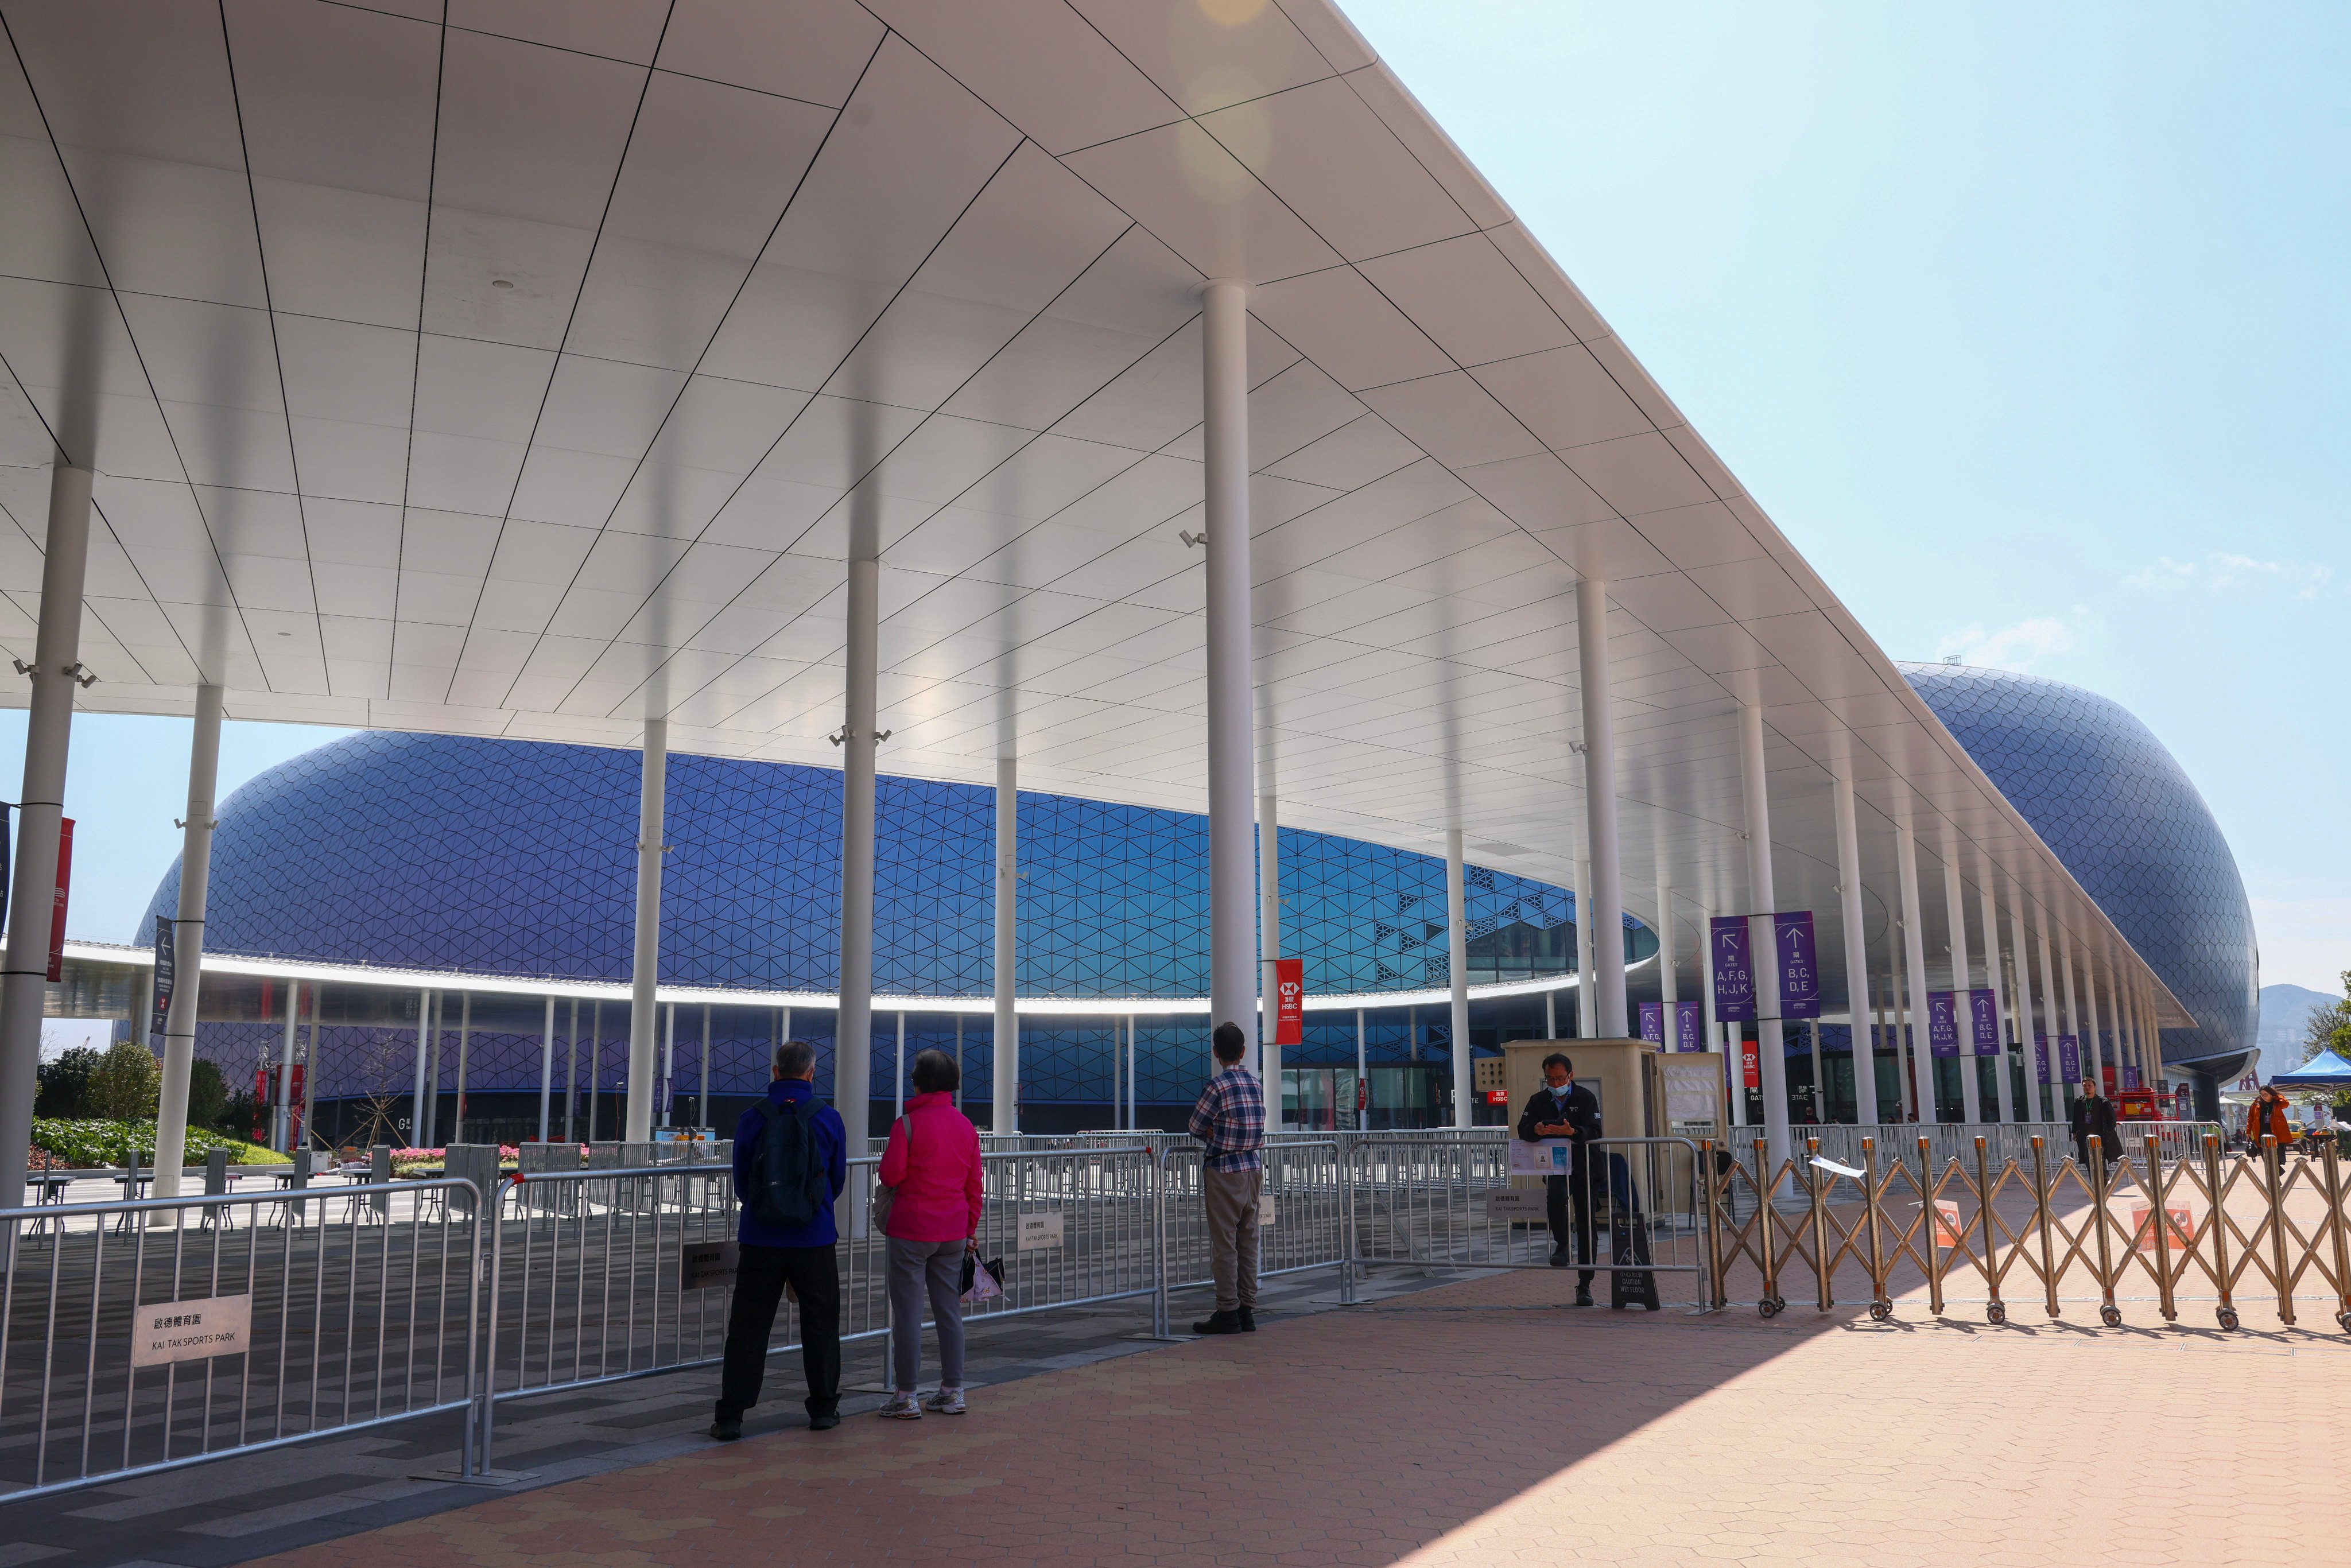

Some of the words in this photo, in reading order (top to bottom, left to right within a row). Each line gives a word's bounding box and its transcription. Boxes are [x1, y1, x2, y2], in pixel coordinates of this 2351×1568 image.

[398, 1118, 405, 1130] G
[153, 1313, 201, 1330] 啟德體育園
[152, 1341, 165, 1350] KAI
[168, 1338, 182, 1348] TAK
[183, 1334, 213, 1346] SPORTS
[215, 1332, 235, 1342] PARK
